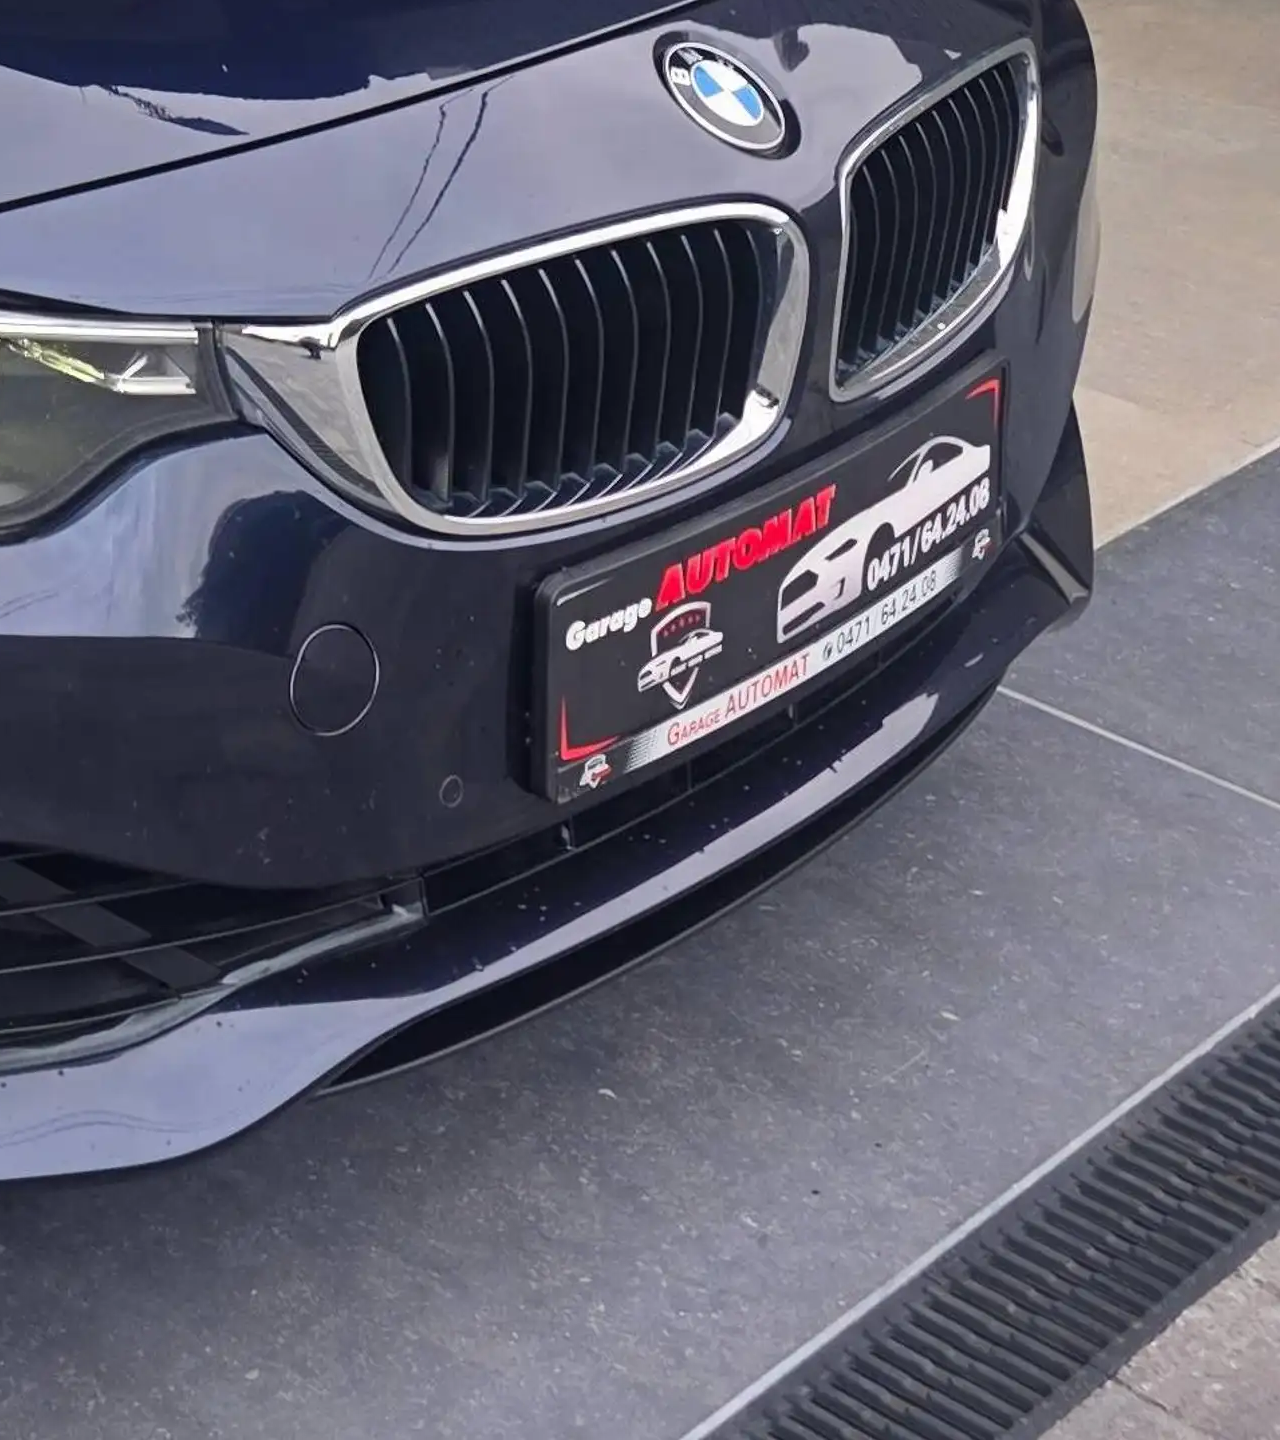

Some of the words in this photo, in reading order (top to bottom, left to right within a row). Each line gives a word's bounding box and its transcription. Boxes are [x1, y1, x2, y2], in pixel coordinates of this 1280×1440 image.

[565, 596, 653, 651] Garage
[656, 482, 837, 611] AUTOMAT
[724, 653, 810, 718] AUTOMAT
